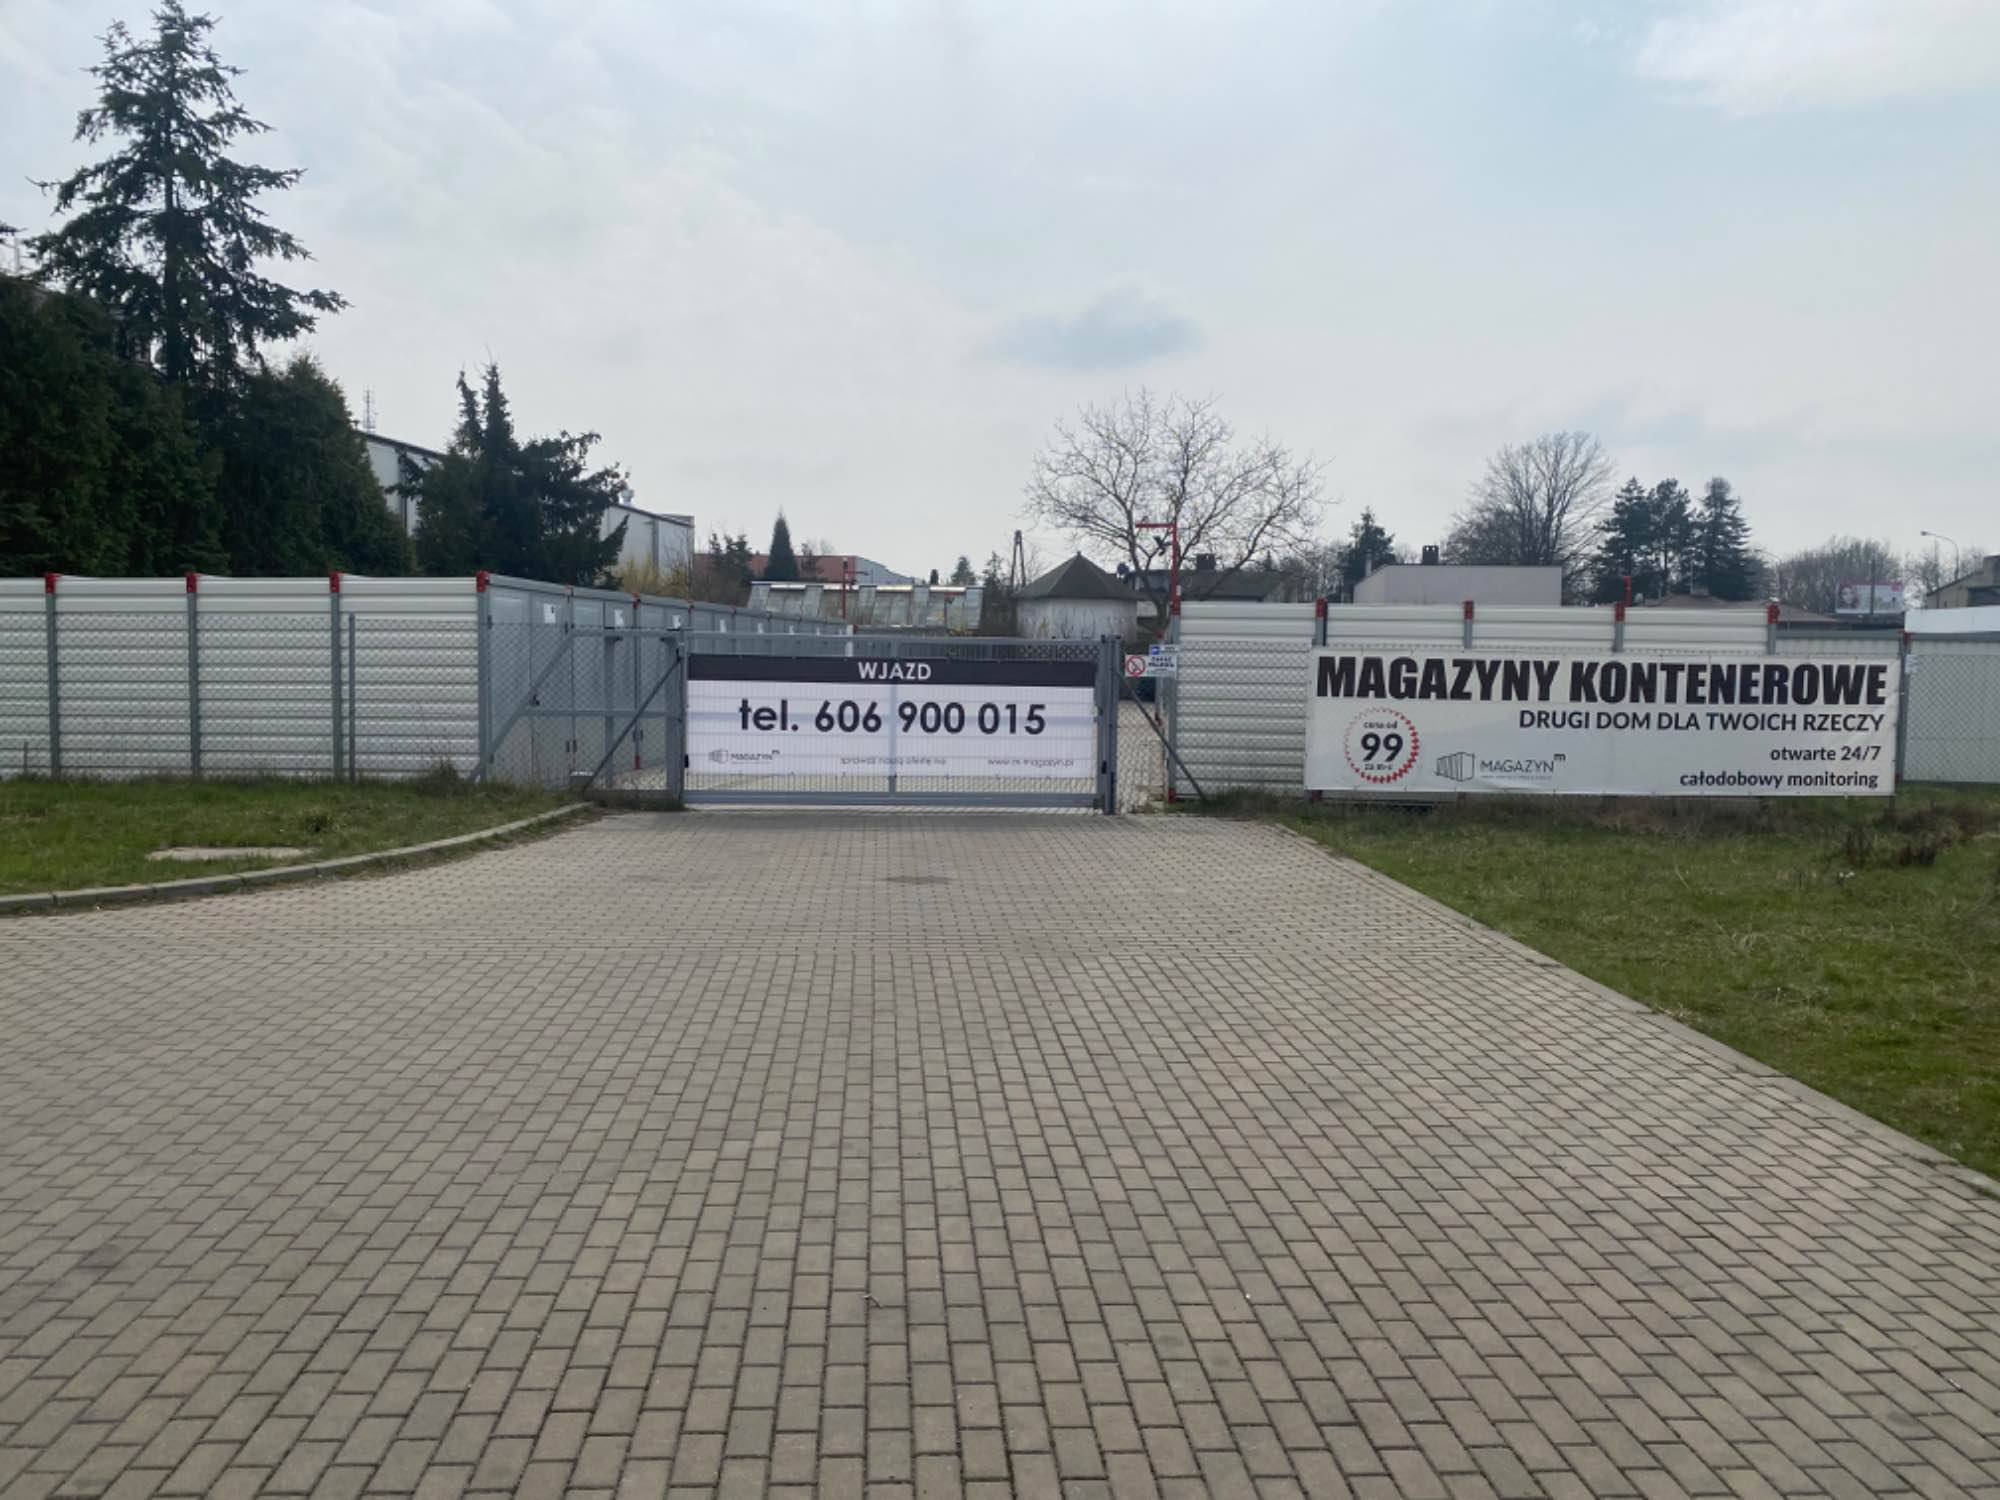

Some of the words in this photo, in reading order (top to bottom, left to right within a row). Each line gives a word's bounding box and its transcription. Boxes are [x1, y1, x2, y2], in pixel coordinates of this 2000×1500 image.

[858, 661, 931, 681] WJAZD
[1316, 656, 1559, 702] MAGAZYNY
[1569, 661, 1888, 706] KONTENEROWE
[739, 698, 799, 732] tel.
[814, 700, 882, 733] 606
[898, 701, 965, 734] 900
[978, 703, 1046, 735] 015
[1519, 710, 1590, 730] DRUGI
[1596, 711, 1650, 730] DOM
[1657, 712, 1700, 731] DLA
[1706, 712, 1797, 732] TWOICH
[1803, 714, 1885, 732] RZECZY
[1361, 732, 1403, 762] 99
[1770, 746, 1836, 761] otwarte
[1840, 746, 1881, 761] 24/7
[1680, 770, 1783, 788] całodobowy
[1787, 771, 1878, 788] monitoring
